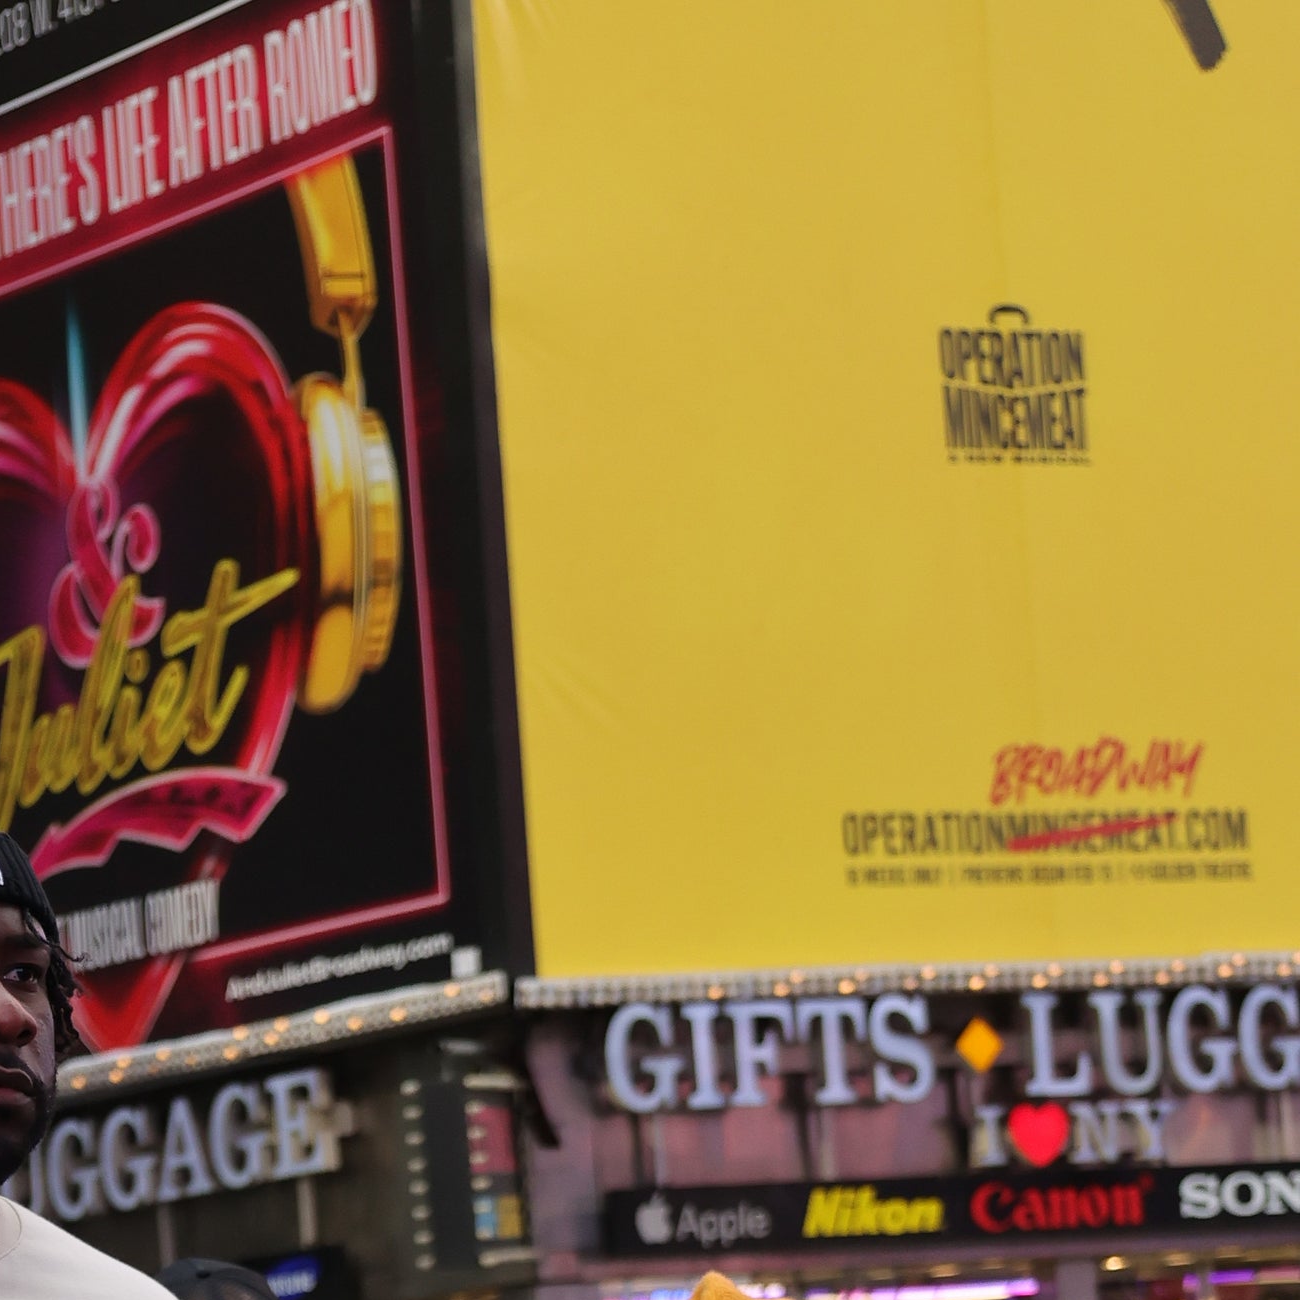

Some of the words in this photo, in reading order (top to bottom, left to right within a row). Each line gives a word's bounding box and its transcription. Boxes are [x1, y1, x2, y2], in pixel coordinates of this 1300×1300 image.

[102, 86, 165, 214] LIFE
[167, 44, 264, 189] AFTER
[263, 0, 377, 145] ROMEO
[941, 329, 1083, 388] OPERATION
[944, 385, 1088, 450] MINCEMEAT
[989, 736, 1204, 806] BROADWAY
[145, 877, 220, 955] COMEDY
[604, 994, 936, 1114] GIFTS
[1021, 984, 1300, 1098] LUGG
[10, 1066, 327, 1221] GGAGE
[1068, 1098, 1174, 1165] NY
[674, 1202, 772, 1248] Apple
[801, 1184, 944, 1238] Nikon
[970, 1180, 1145, 1234] Canon
